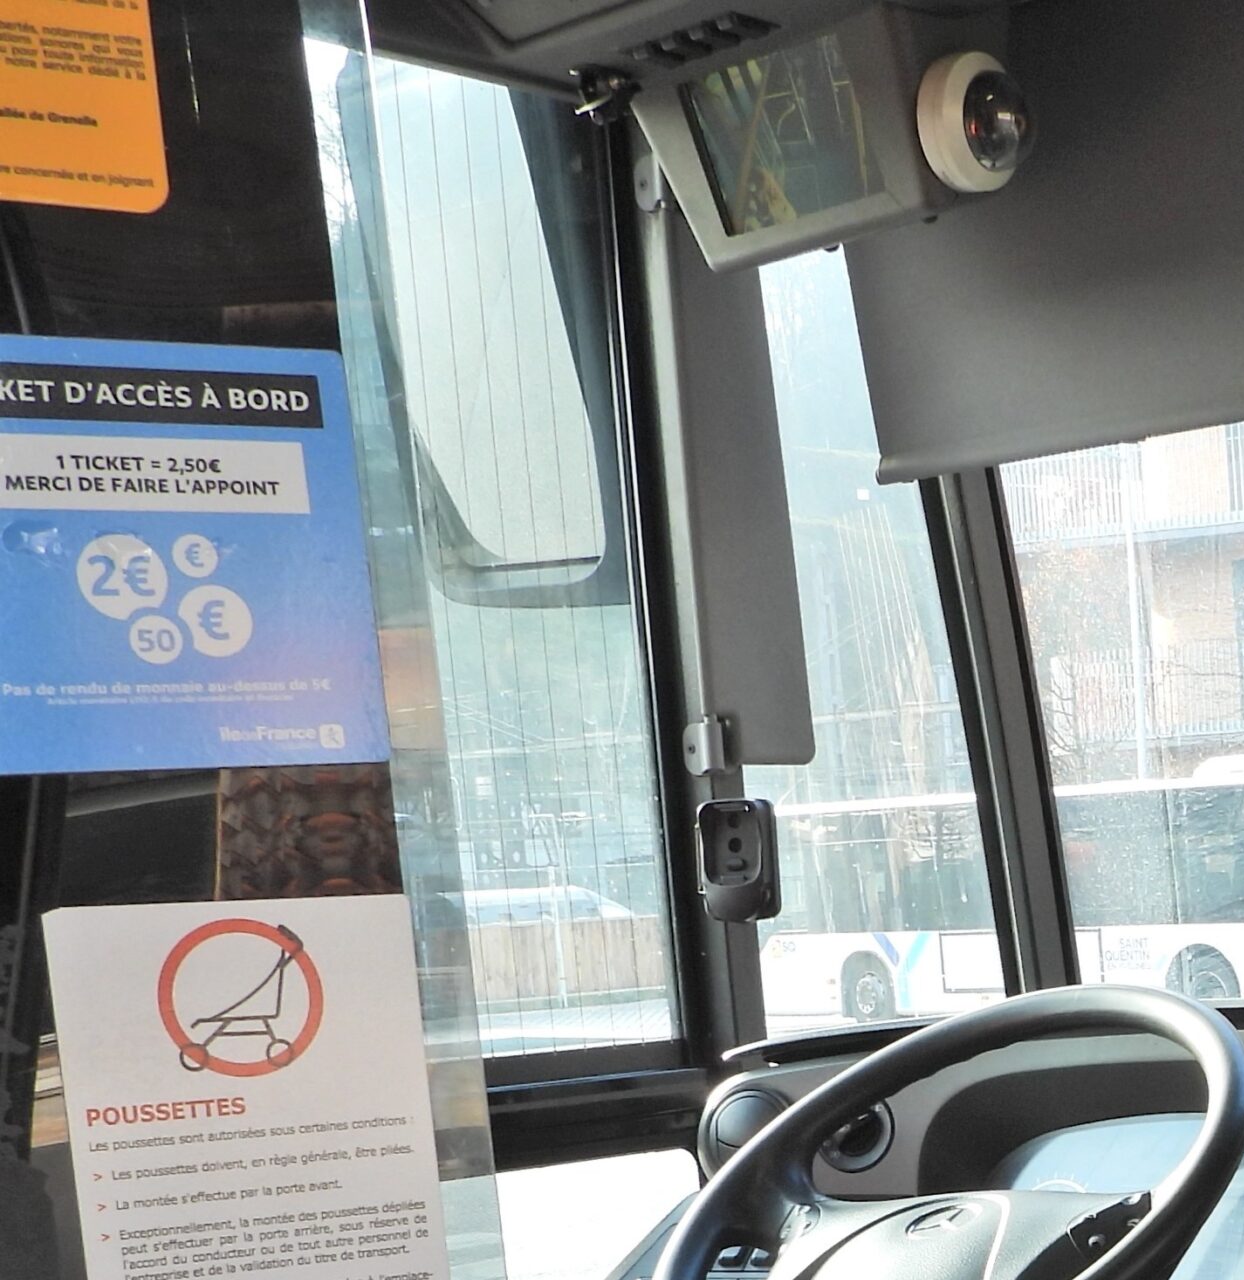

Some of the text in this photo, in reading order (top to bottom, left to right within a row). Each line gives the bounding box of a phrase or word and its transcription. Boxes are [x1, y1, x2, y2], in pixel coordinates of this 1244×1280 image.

[42, 62, 82, 74] service
[29, 110, 44, 121] de
[47, 111, 98, 127] Grenelle
[13, 166, 75, 180] concernée
[77, 172, 89, 182] et
[91, 175, 106, 184] en
[108, 175, 154, 188] joignant
[64, 377, 192, 409] D'ACCÈS
[201, 380, 221, 409] À
[228, 387, 310, 412] BORD
[56, 455, 221, 475] 1 TICKET = 2,50€
[5, 474, 279, 496] MERCI DE FAIRE L'APPOINT
[87, 555, 156, 597] 2€
[136, 629, 176, 652] 50
[3, 678, 332, 696] Pas de rendu de monnaie au-dessus de 5€
[1105, 950, 1150, 961] QUENTIN
[1120, 937, 1148, 949] SAINT
[86, 1097, 246, 1127] POUSSETTES
[89, 1115, 406, 1152] Les poussettes sont autorisées sous certaines conditions
[112, 1144, 414, 1181] Les poussettes doivent, en règle générale, être pliées.
[116, 1180, 343, 1210] La montée s'effectue par la porte avant.
[119, 1200, 425, 1241] Exceptionnellement, la montée des poussettes dépliées
[121, 1214, 428, 1256] peut s'effectuer par la porte arrière, sous réserve de
[123, 1228, 429, 1270] l'accord du conducteur ou de tout autre personnel de
[193, 1267, 205, 1277] et
[208, 1265, 223, 1276] de
[226, 1263, 236, 1274] la
[240, 1257, 294, 1272] validation
[297, 1255, 311, 1265] du
[315, 1252, 337, 1263] titre
[340, 1250, 354, 1261] de
[358, 1244, 410, 1260] transport.
